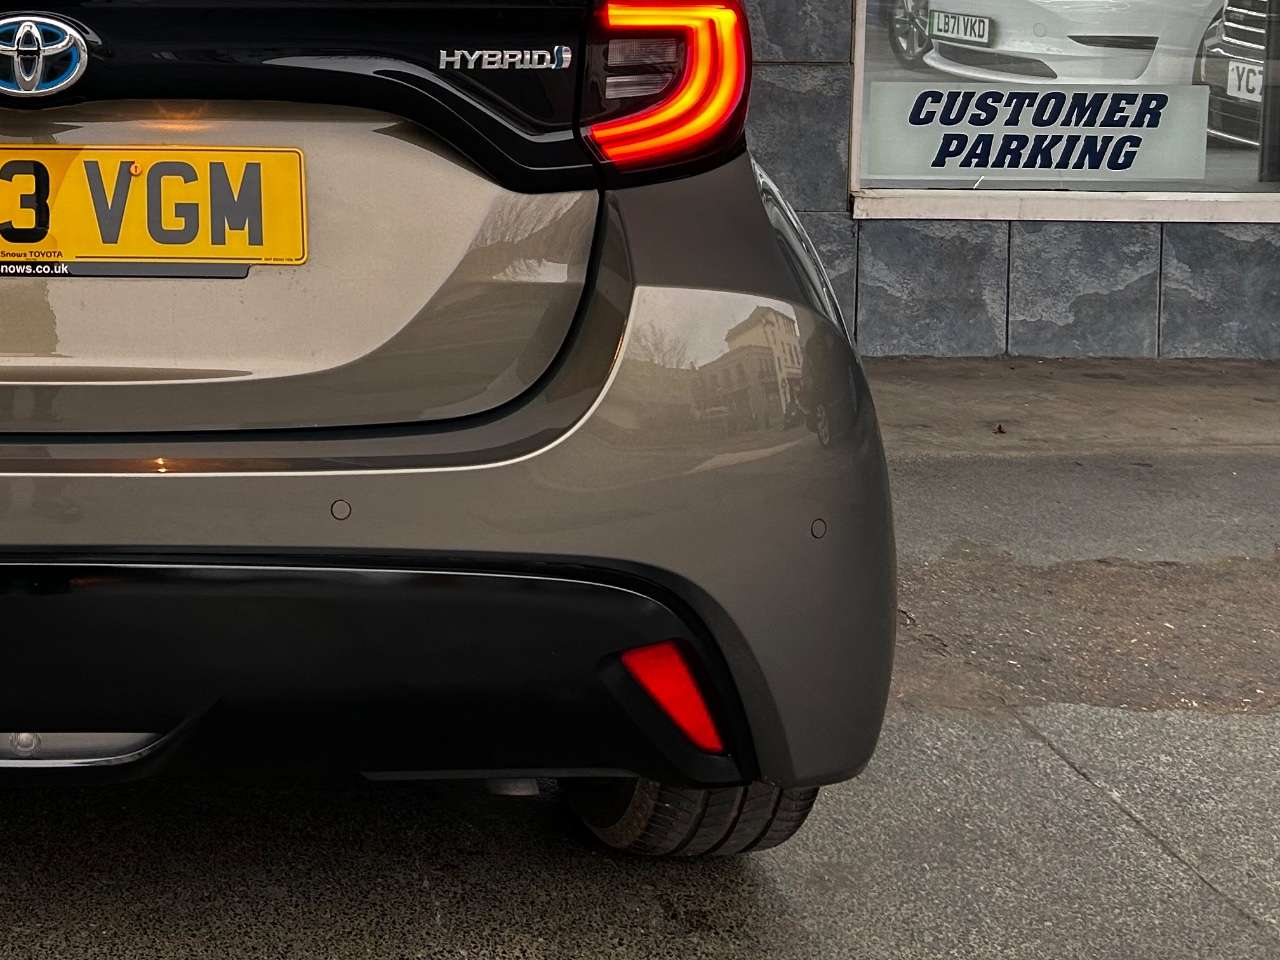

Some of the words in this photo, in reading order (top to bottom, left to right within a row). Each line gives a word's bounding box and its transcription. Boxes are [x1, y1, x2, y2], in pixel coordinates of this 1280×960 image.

[937, 13, 960, 35] LB71
[963, 16, 985, 39] VKD
[439, 49, 552, 70] HYBRID
[908, 90, 1169, 128] CUSTOMER
[930, 132, 1143, 171] PARKING
[83, 160, 264, 246] VGM
[0, 250, 27, 258] Snows
[29, 250, 63, 258] TOYOTA
